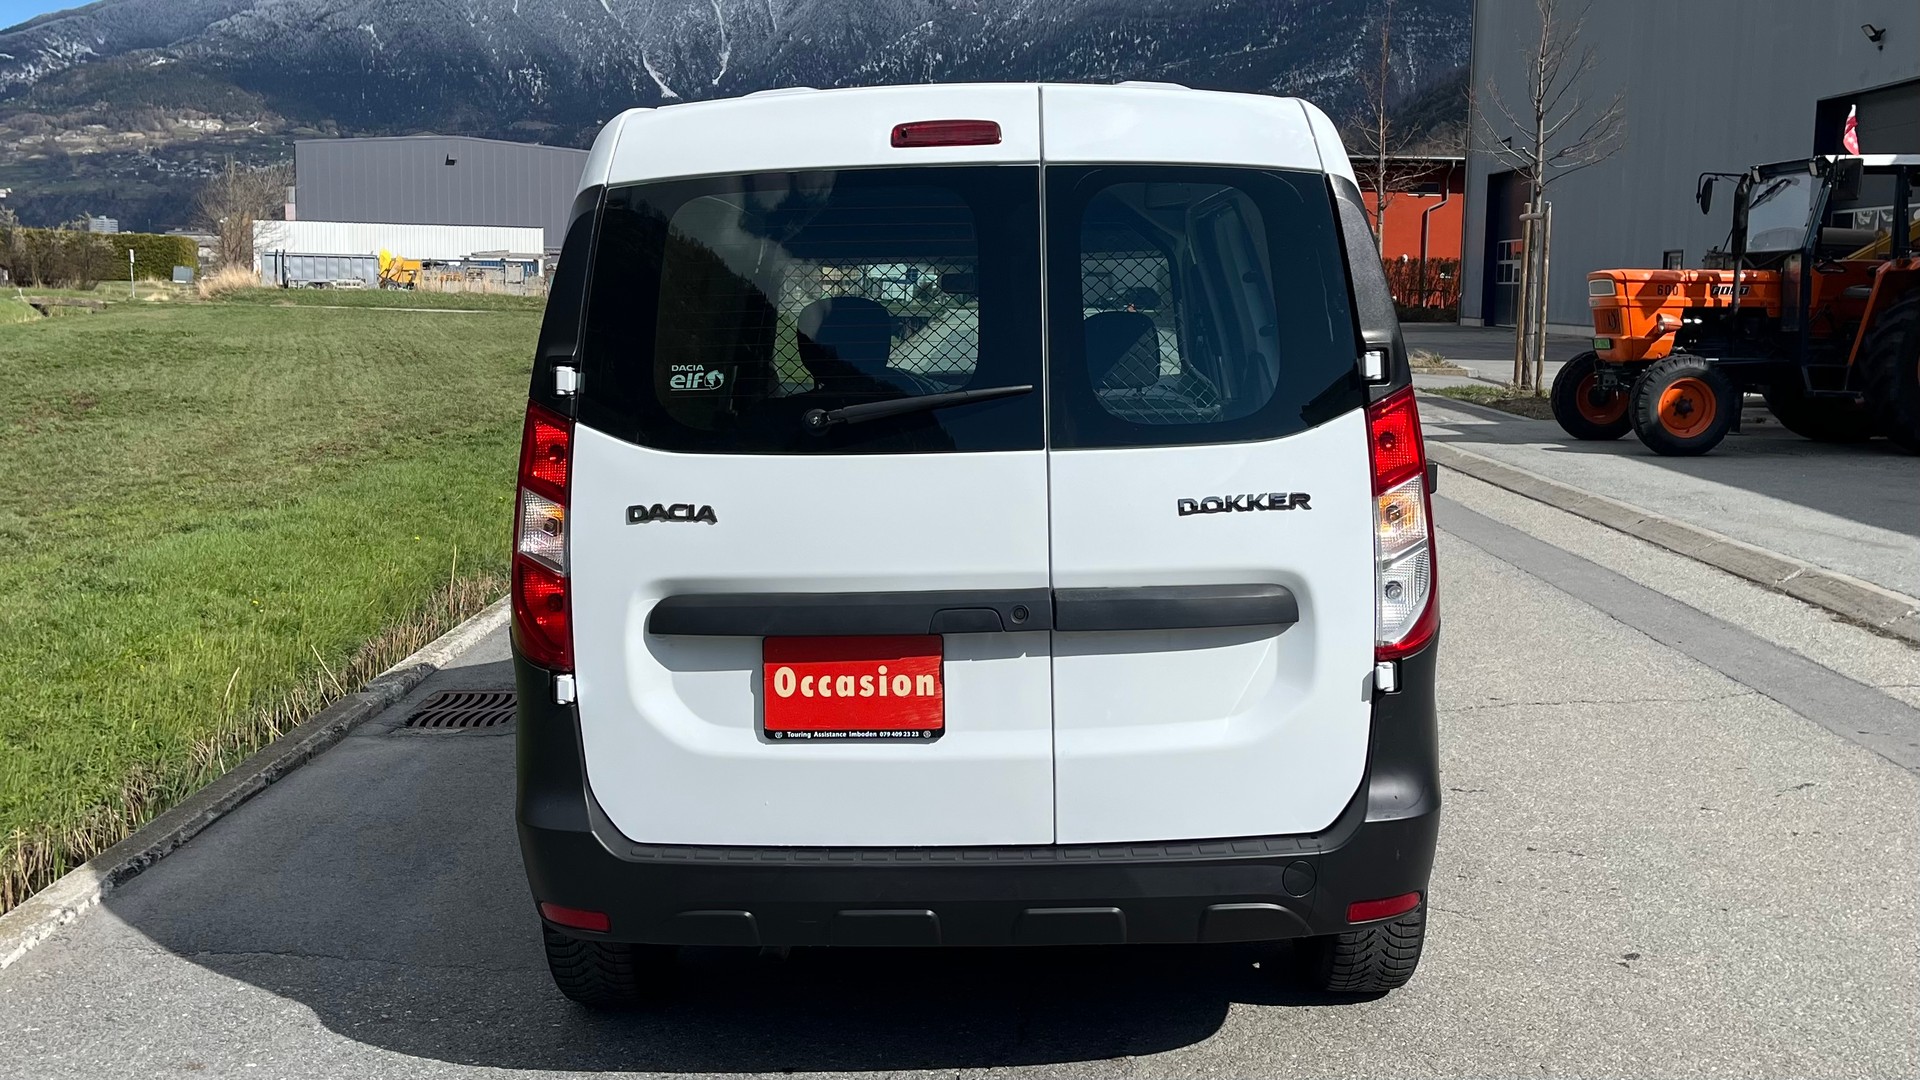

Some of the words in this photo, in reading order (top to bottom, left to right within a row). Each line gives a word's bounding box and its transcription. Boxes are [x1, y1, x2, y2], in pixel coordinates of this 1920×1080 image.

[1657, 285, 1678, 296] 600
[1712, 285, 1749, 296] FIT
[670, 372, 704, 389] elf
[1178, 492, 1312, 516] DOKKER
[626, 503, 718, 525] DACIA
[774, 665, 935, 698] Occasion
[786, 731, 812, 739] Touring
